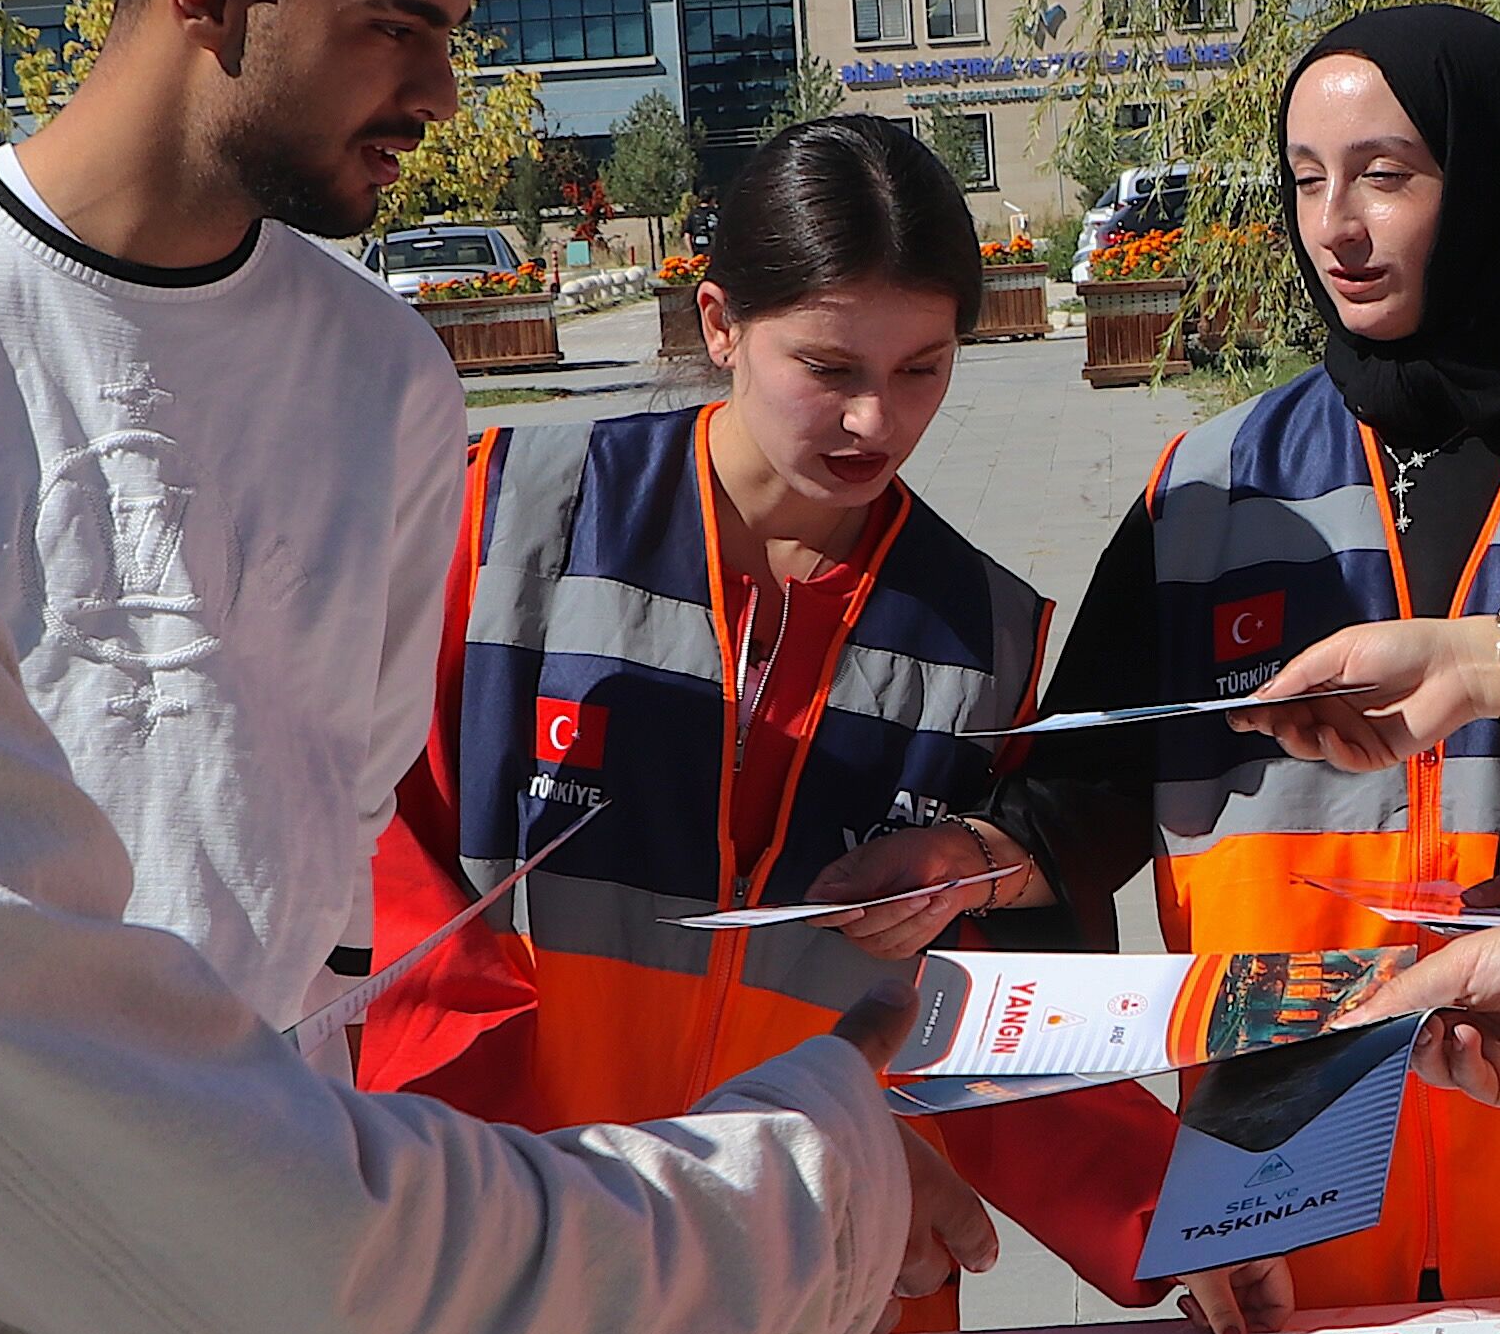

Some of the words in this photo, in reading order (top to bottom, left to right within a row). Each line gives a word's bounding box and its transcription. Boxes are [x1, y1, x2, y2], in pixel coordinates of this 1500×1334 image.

[843, 60, 894, 83] BİLİM
[528, 773, 602, 807] TÜRKİYE
[990, 981, 1037, 1055] YANGIN
[1181, 1189, 1339, 1241] TAŞKINLAR
[1226, 1196, 1267, 1214] SEL
[1274, 1187, 1299, 1200] ve
